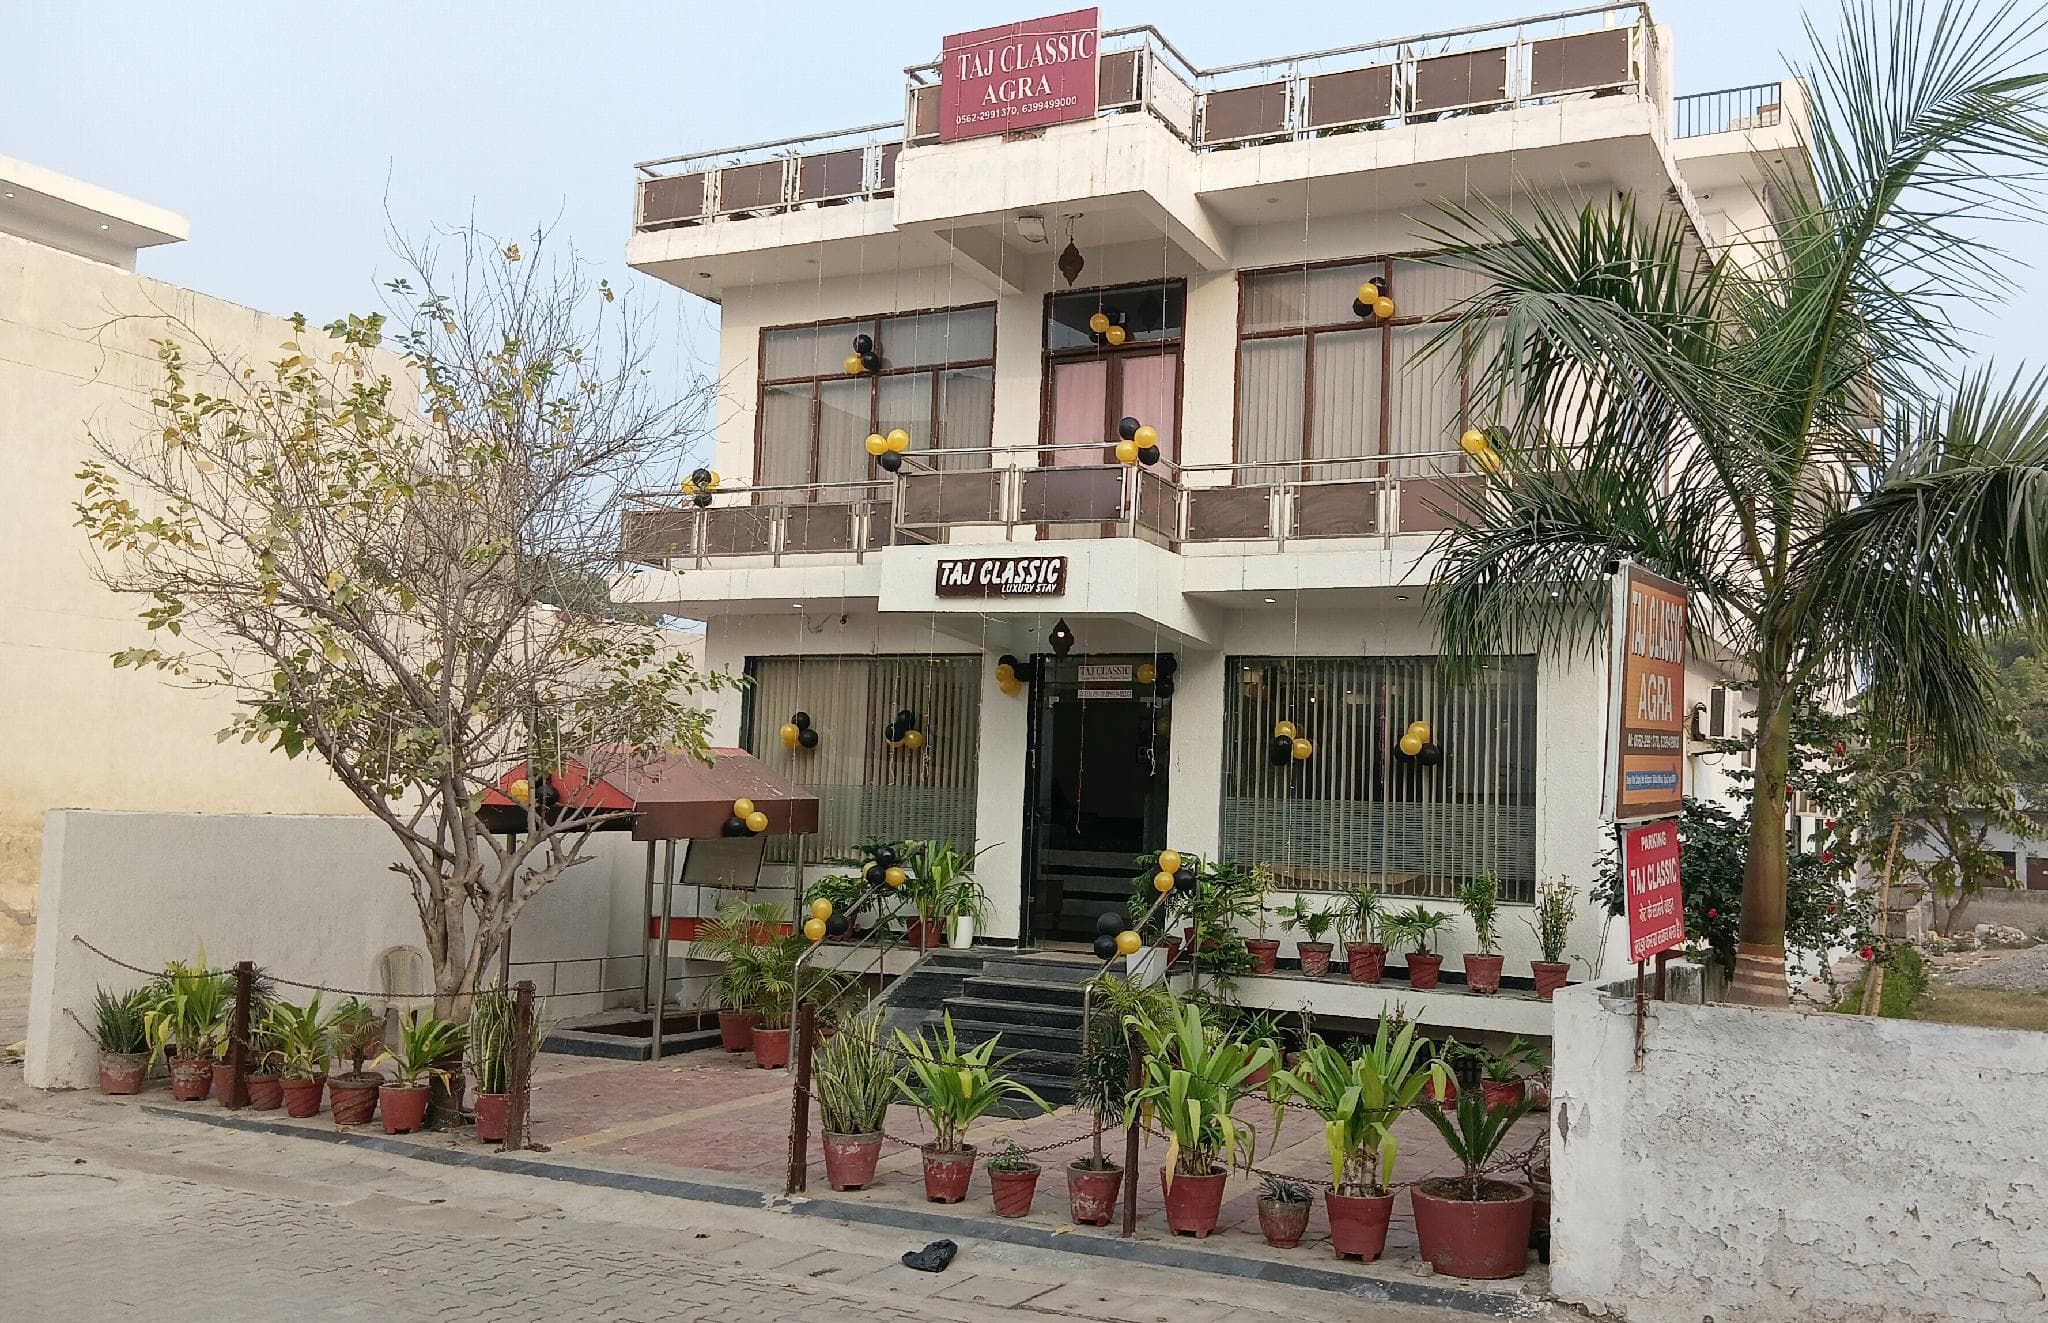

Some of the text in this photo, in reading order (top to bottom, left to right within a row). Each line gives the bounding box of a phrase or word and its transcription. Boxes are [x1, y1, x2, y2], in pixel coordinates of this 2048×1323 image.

[958, 31, 1095, 81] TAJ CLASSIC
[982, 74, 1052, 106] AGRA
[1021, 96, 1077, 113] 6399499000
[941, 558, 1061, 586] TAJ CLASSIC
[1001, 583, 1057, 593] LUXURY STAY
[1631, 590, 1683, 666] TAJ CLASSIC
[1080, 666, 1131, 676] TAJ CLASSIC
[1637, 672, 1673, 722] AGRA
[1640, 831, 1667, 852] PARKING
[1630, 857, 1677, 896] TAJ CLASSIC
